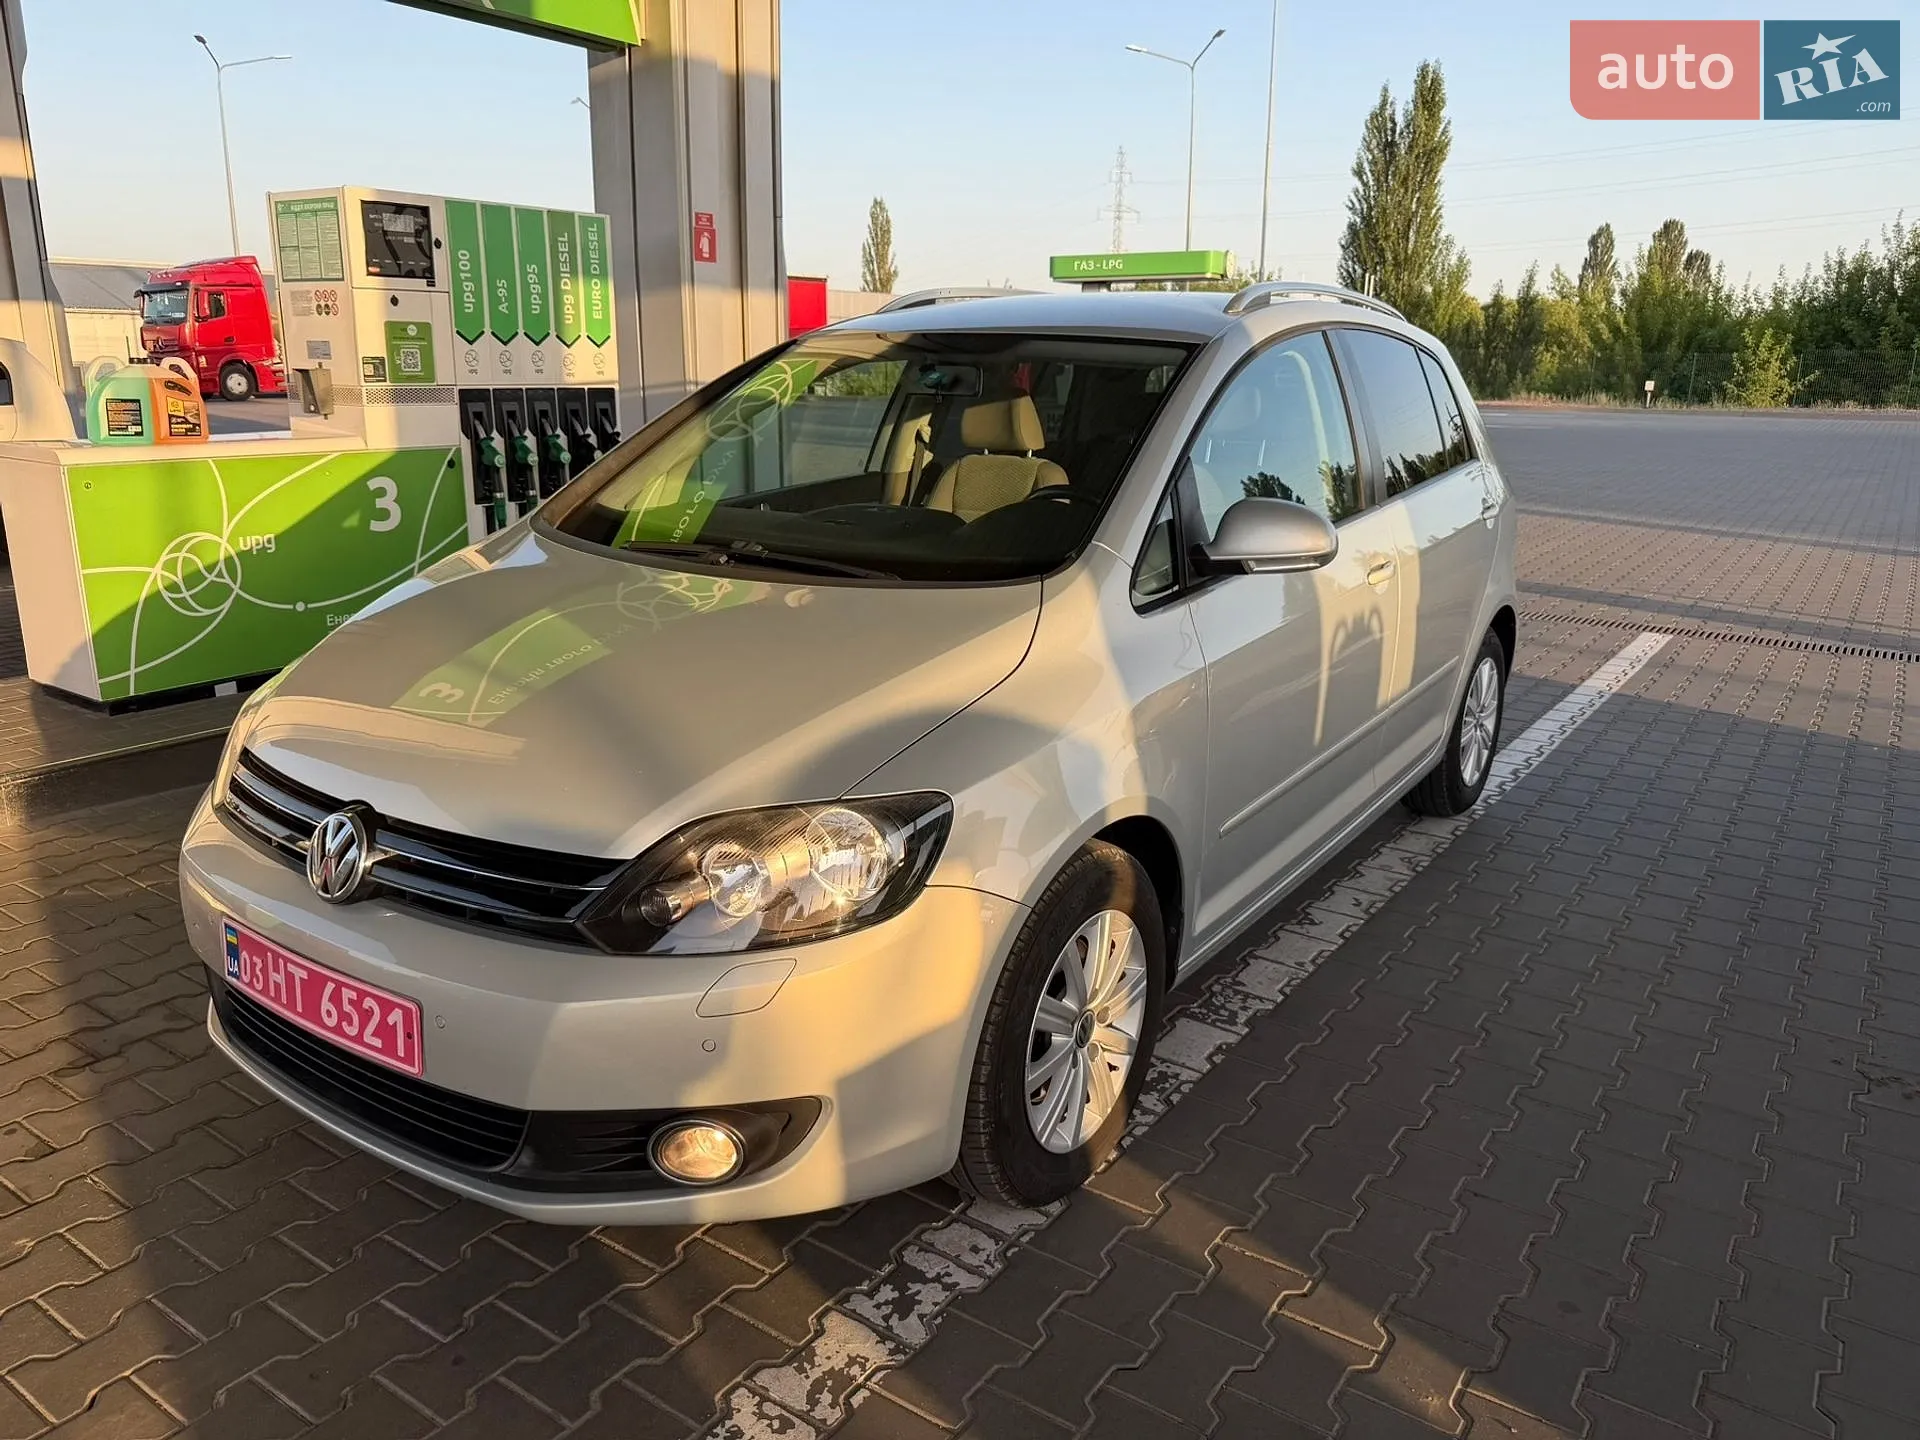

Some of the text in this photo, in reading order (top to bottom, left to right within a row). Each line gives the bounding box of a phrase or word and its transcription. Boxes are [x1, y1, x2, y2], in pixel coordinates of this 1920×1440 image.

[458, 249, 476, 313] upg100
[526, 263, 542, 314] upg95
[557, 232, 576, 324] upg DIESEL
[588, 223, 603, 319] EURO DIESEL
[366, 475, 402, 532] 3
[239, 533, 276, 555] upg
[227, 955, 240, 976] UA
[320, 980, 408, 1058] 6521
